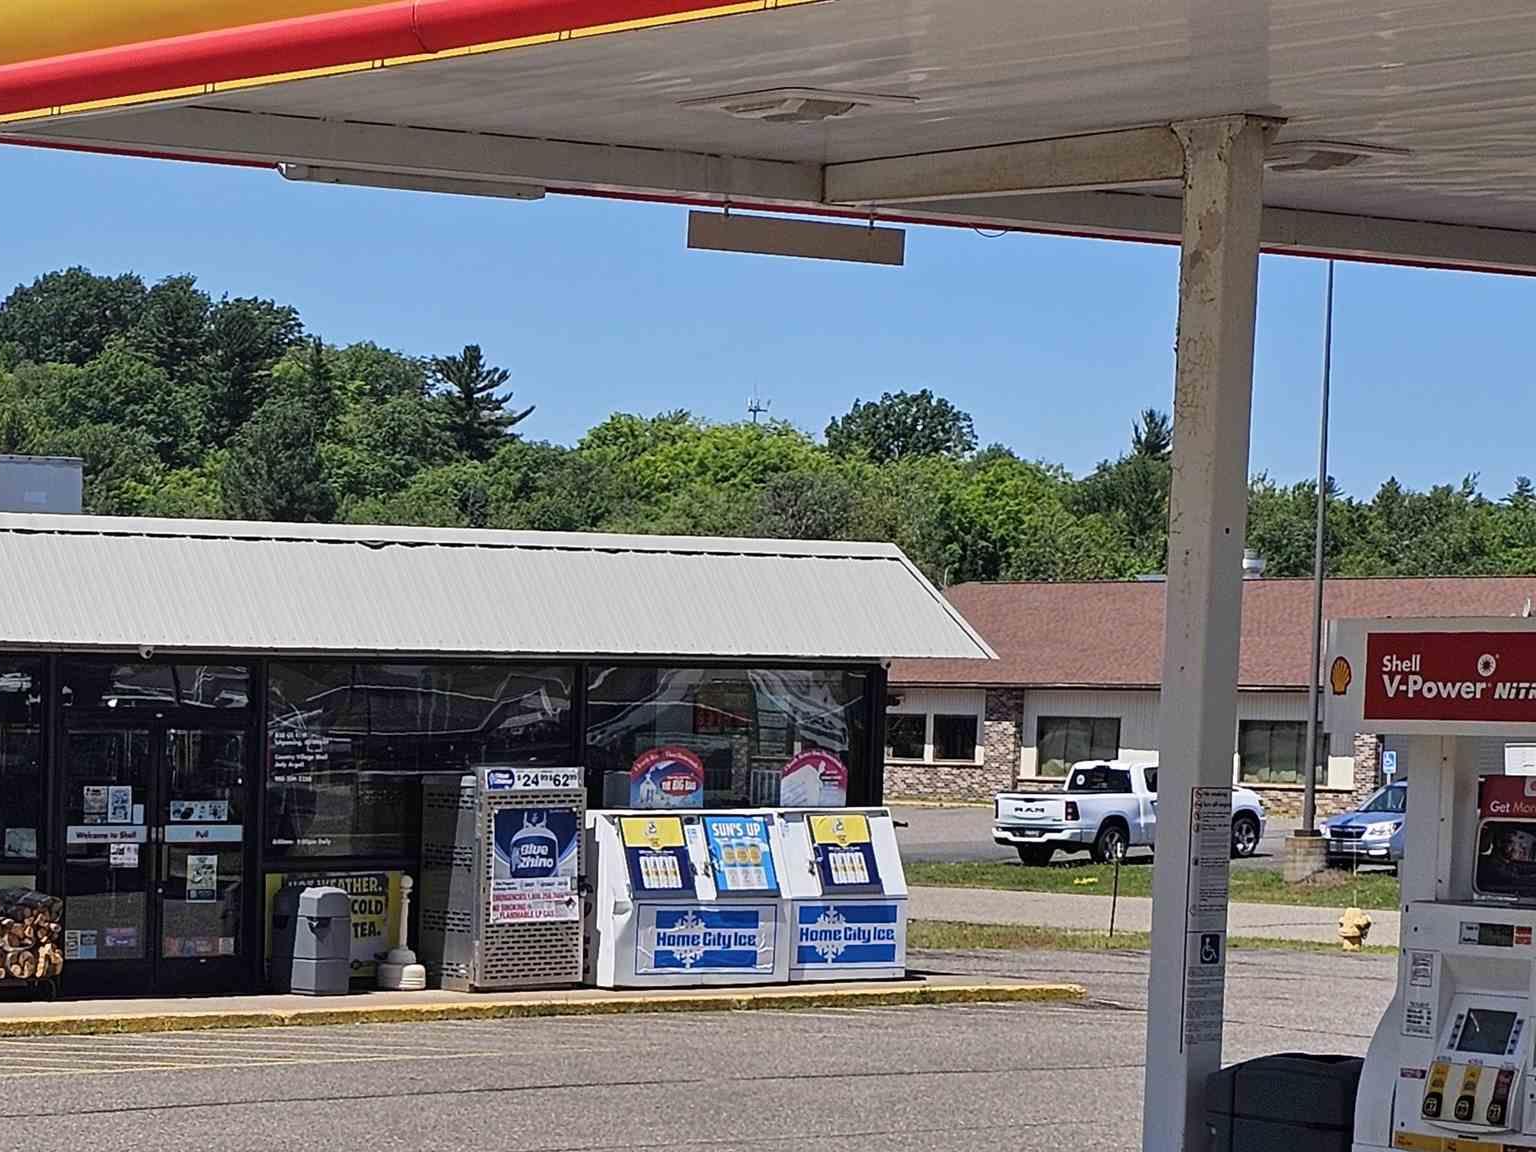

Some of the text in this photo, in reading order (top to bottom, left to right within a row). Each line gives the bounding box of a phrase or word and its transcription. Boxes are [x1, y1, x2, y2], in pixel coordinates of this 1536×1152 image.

[1382, 654, 1421, 672] Shell
[1382, 674, 1486, 699] V-Power
[1490, 800, 1510, 813] Get
[75, 831, 108, 839] Welcome
[119, 830, 136, 839] Shell
[712, 823, 762, 837] SUN'S UP
[520, 844, 549, 856] Blue
[351, 899, 384, 915] COLD
[351, 921, 382, 938] TEA.
[799, 925, 895, 943] Home City Ice
[656, 931, 757, 949] Home City Ice
